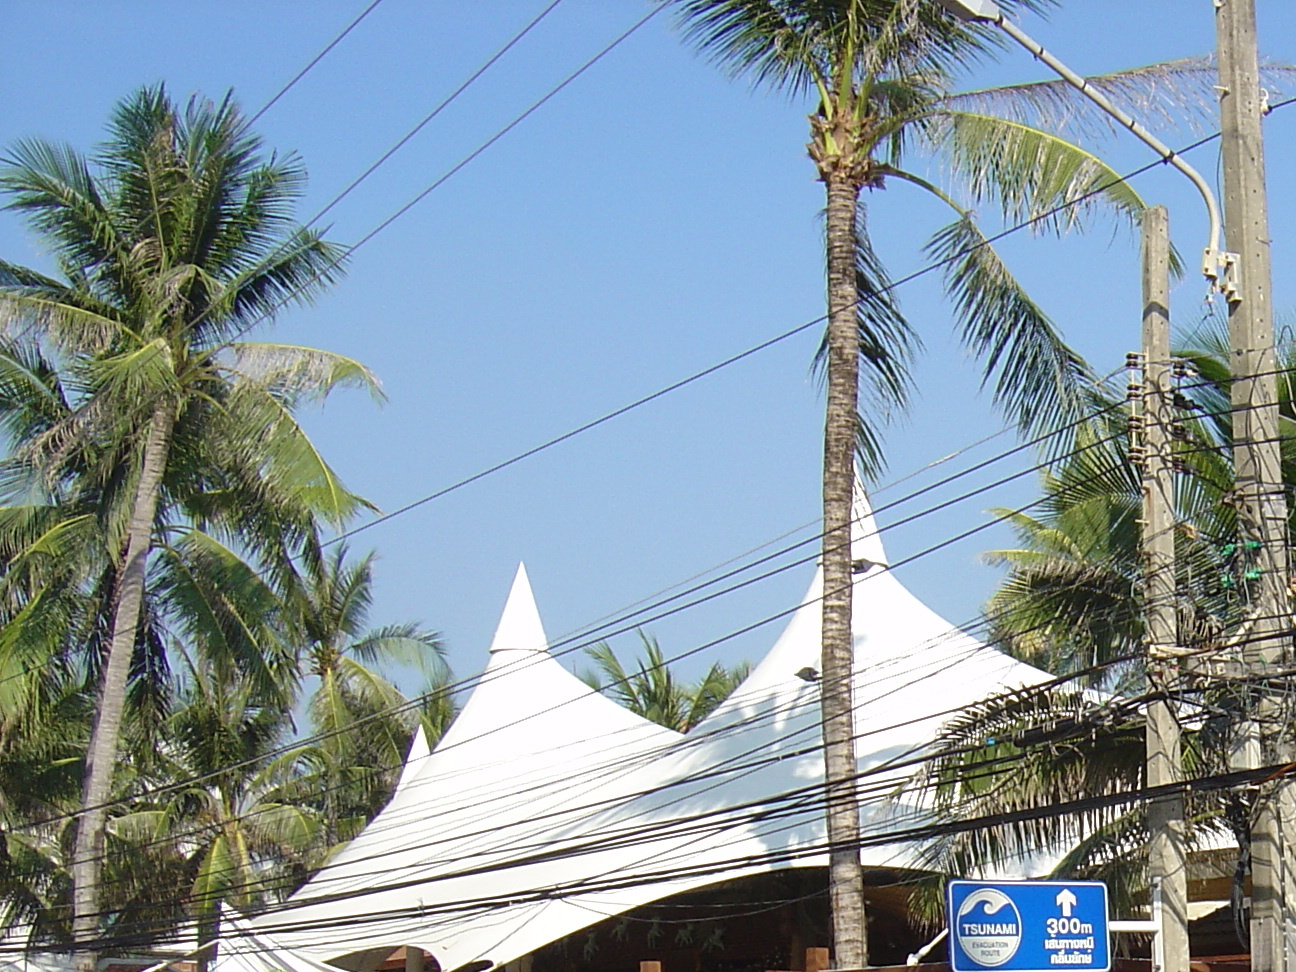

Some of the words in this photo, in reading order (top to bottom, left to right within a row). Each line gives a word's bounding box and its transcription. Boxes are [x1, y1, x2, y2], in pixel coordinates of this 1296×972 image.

[962, 923, 1017, 935] TSUNAMI
[1046, 918, 1093, 934] 300m
[971, 941, 1009, 949] EVACUATION
[980, 949, 1001, 957] ROUTE
